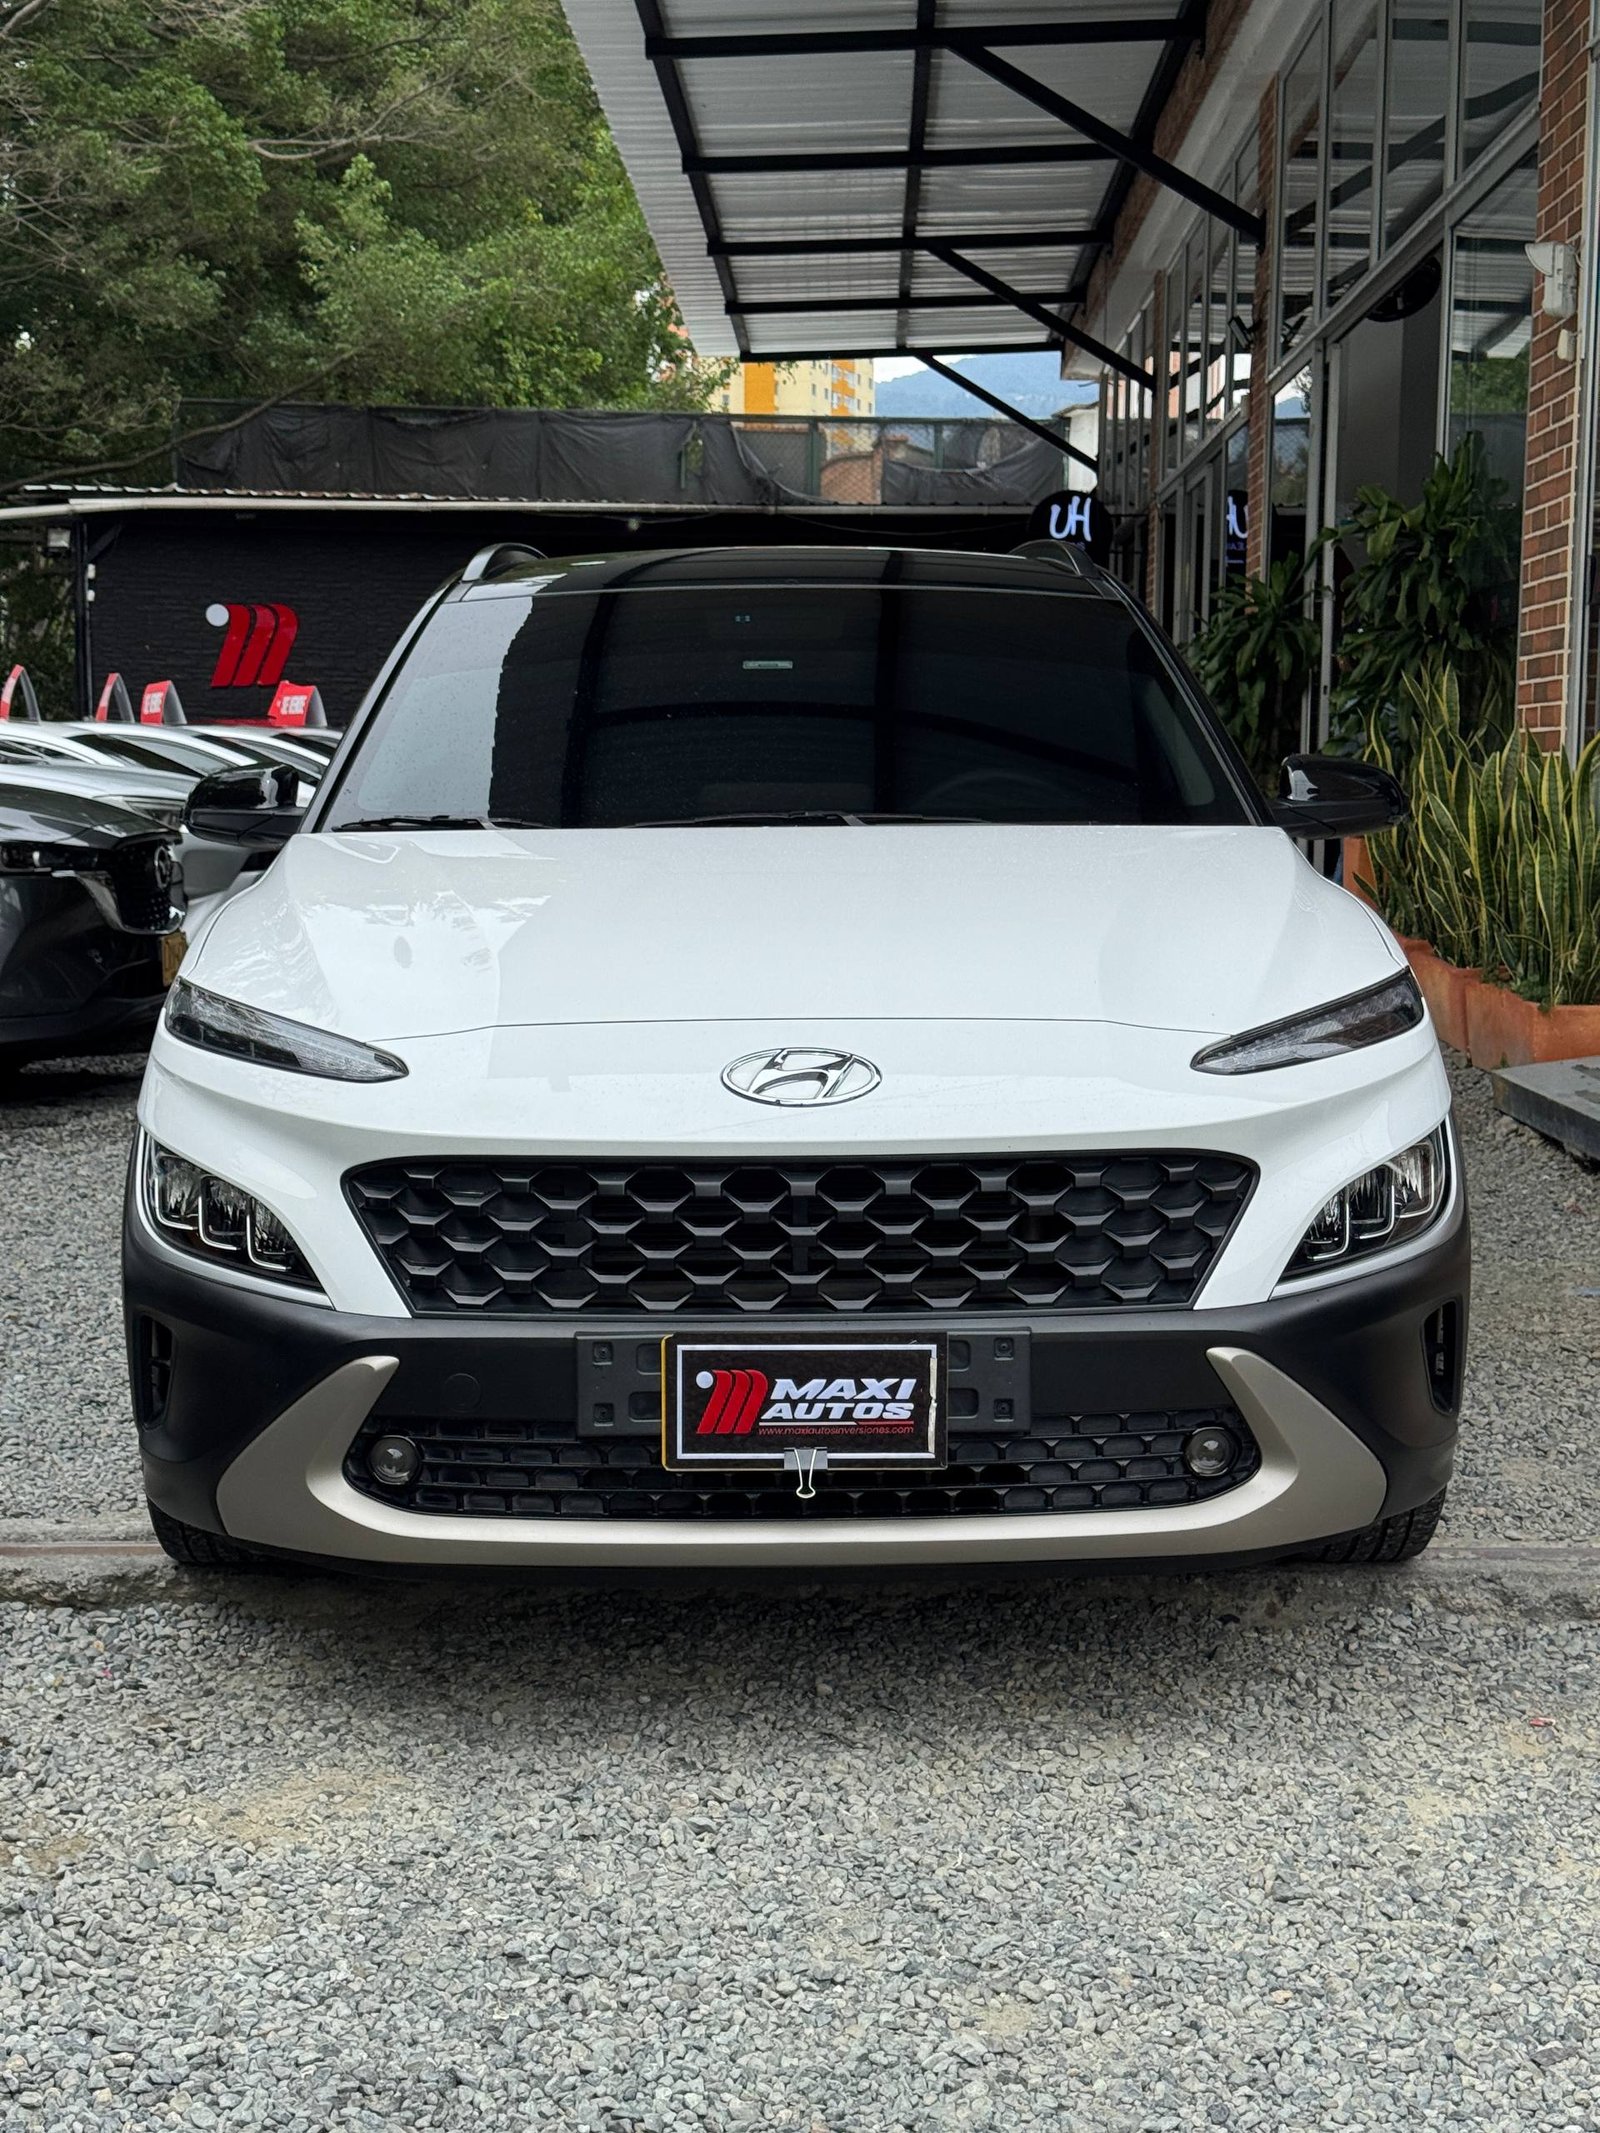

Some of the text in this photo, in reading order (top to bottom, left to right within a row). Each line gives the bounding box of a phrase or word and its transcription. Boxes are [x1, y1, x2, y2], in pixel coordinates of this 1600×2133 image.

[770, 1378, 917, 1400] MAXI
[760, 1402, 915, 1420] AUTOS
[758, 1425, 915, 1436] www.maxiautosinversiones.com
